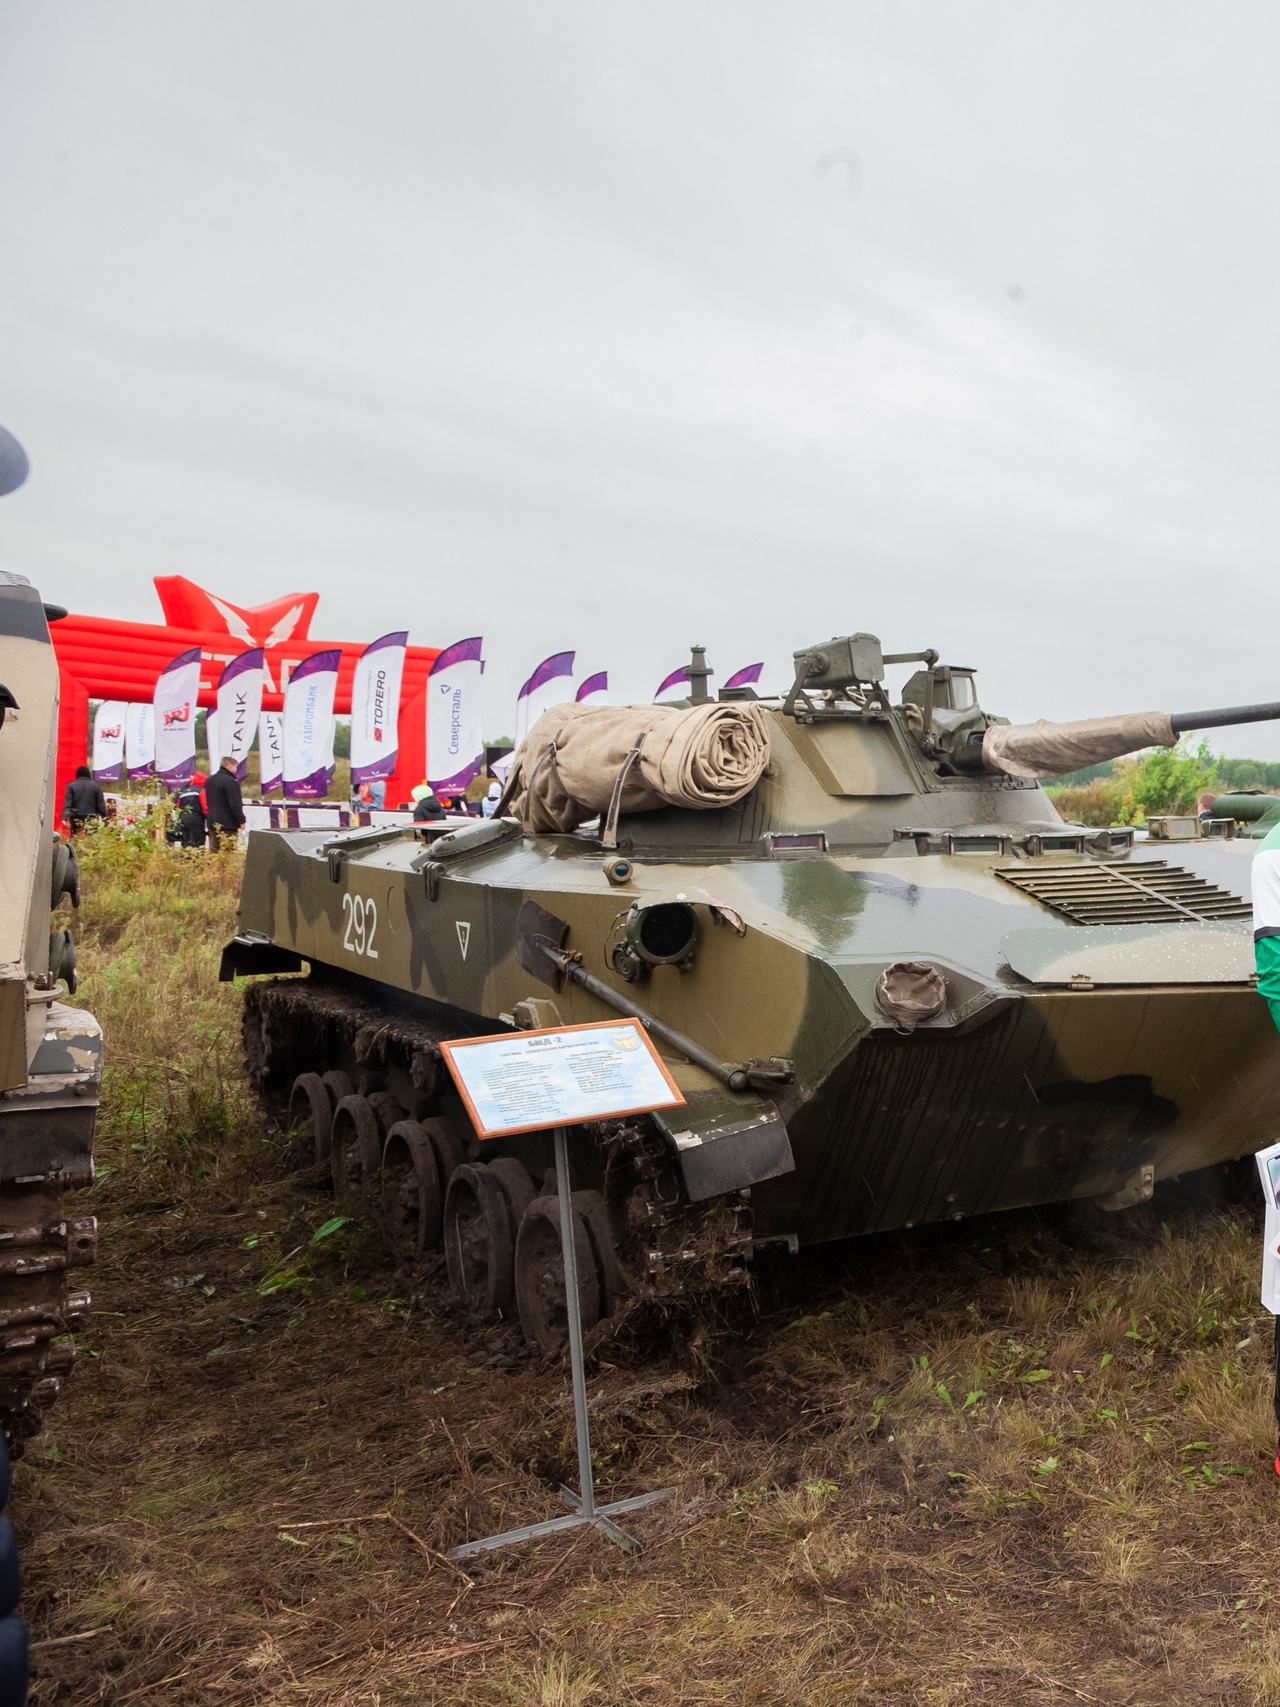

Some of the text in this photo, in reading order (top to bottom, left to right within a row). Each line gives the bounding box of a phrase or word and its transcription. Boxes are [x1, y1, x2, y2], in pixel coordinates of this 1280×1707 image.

[231, 691, 248, 757] TANK
[303, 685, 318, 744] ГАЗПРОМБАНК
[373, 670, 386, 726] TORERO
[448, 688, 462, 755] Северсталь
[342, 893, 379, 959] 292
